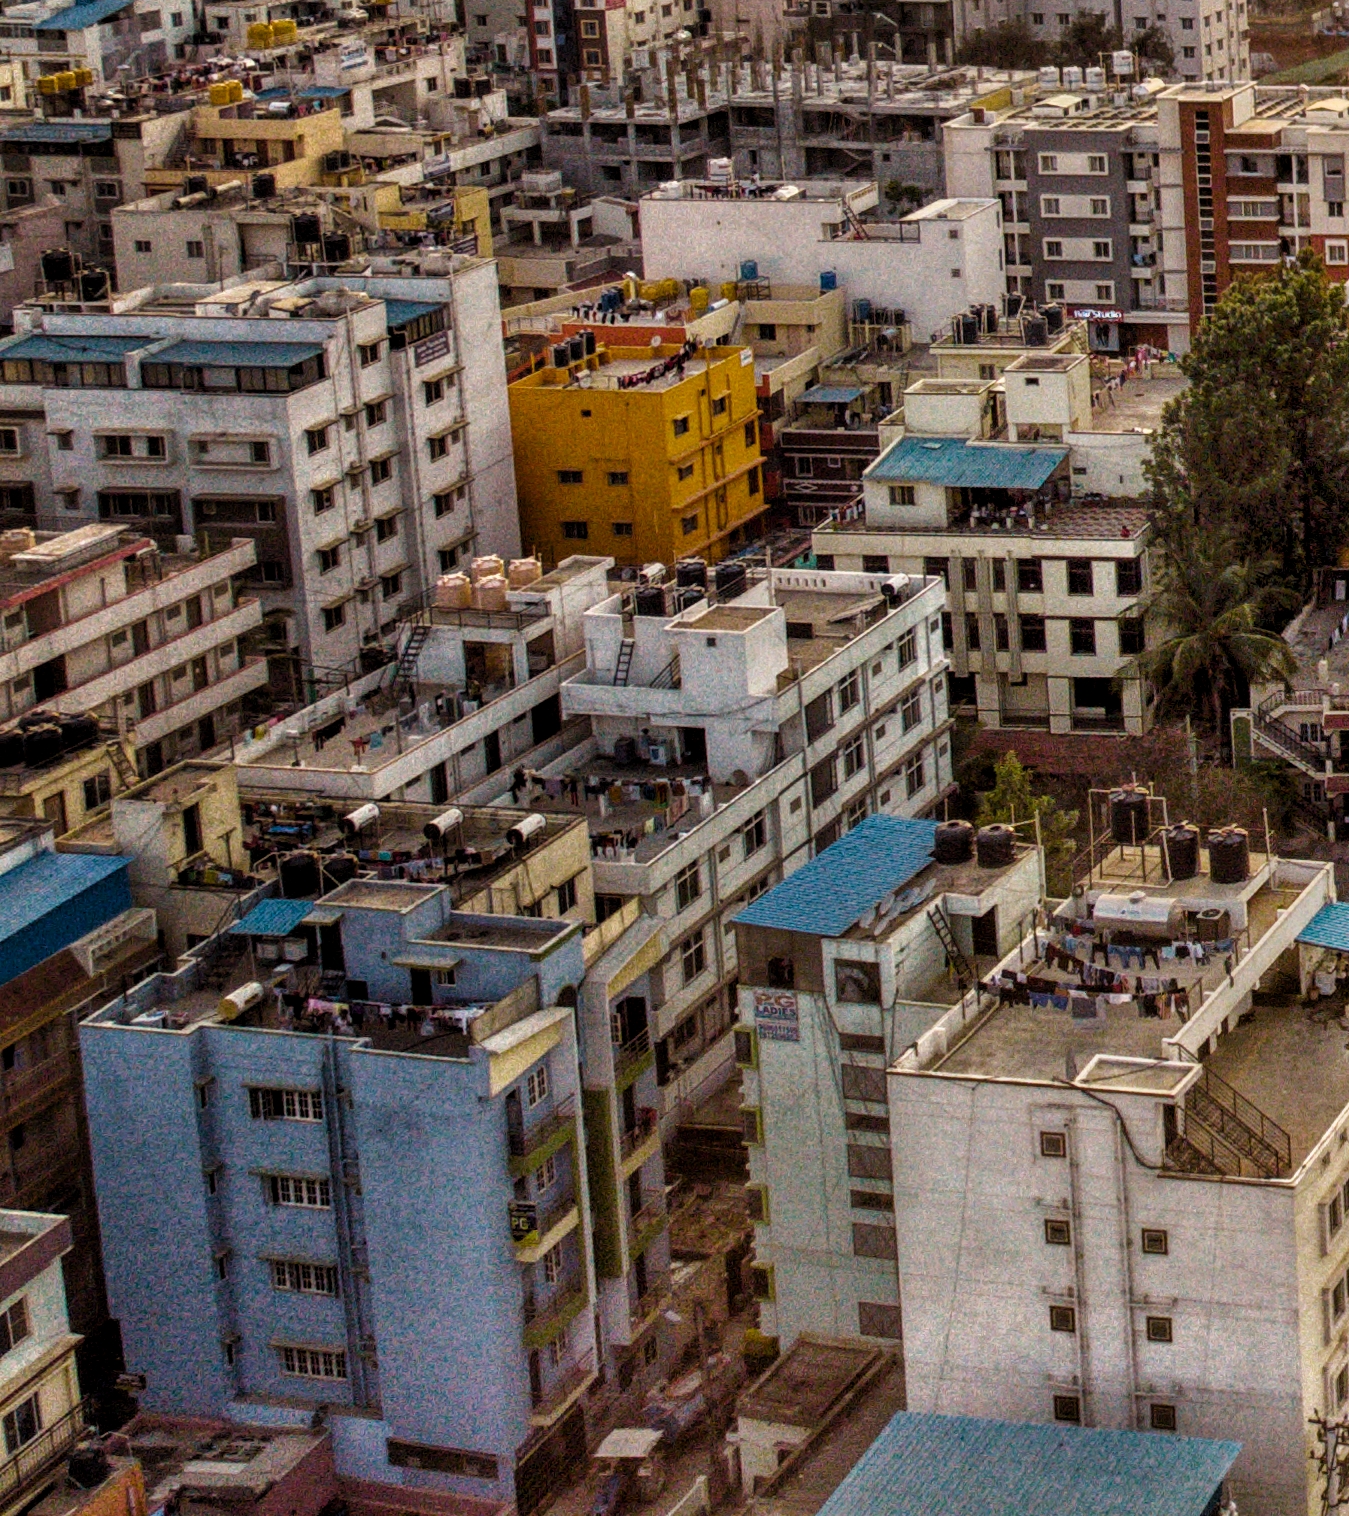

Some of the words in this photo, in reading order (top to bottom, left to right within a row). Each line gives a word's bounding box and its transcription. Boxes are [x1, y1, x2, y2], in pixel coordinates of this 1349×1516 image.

[755, 993, 794, 1008] PG
[755, 1005, 796, 1018] LADIES
[511, 1217, 528, 1230] PG
